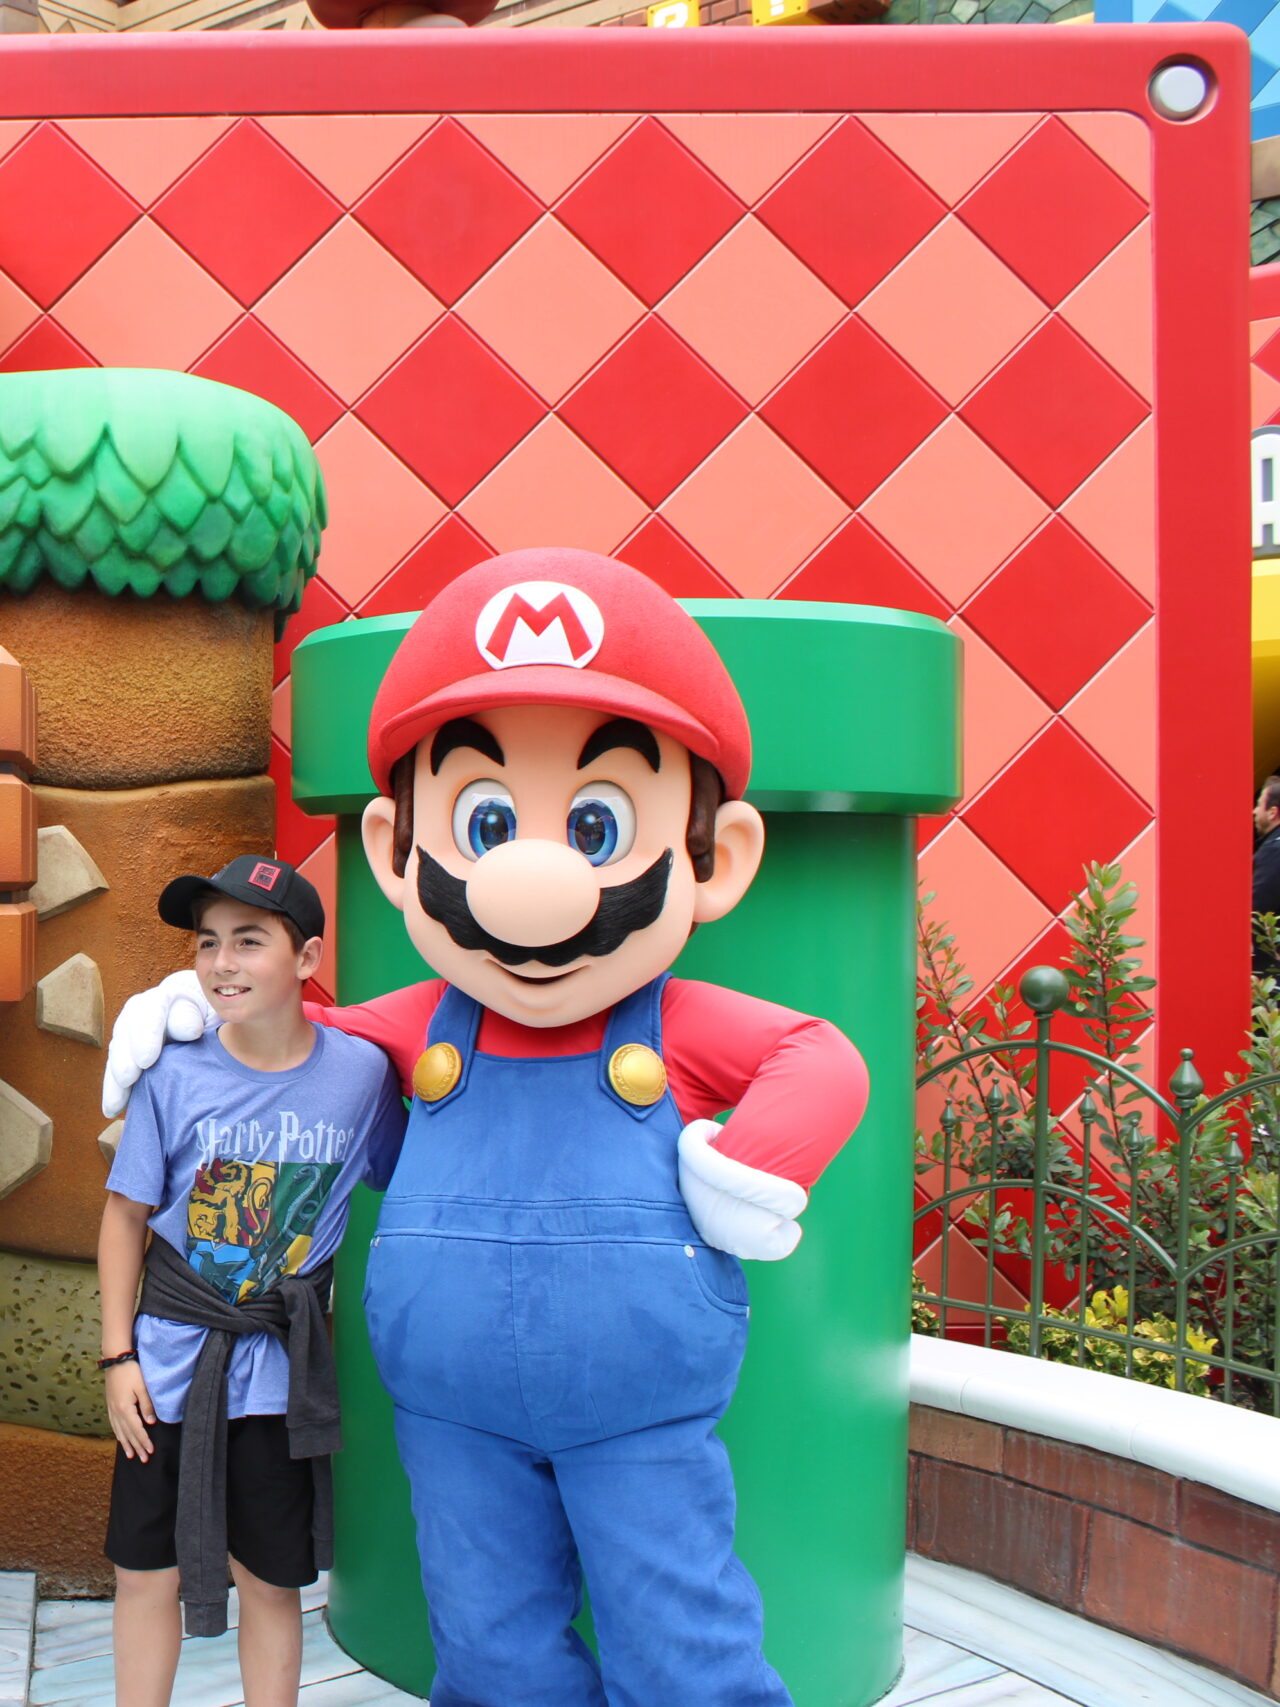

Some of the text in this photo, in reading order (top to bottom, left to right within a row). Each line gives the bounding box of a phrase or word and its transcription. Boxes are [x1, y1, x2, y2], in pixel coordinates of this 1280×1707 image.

[485, 591, 593, 663] M
[195, 1111, 355, 1177] Harry Potter
